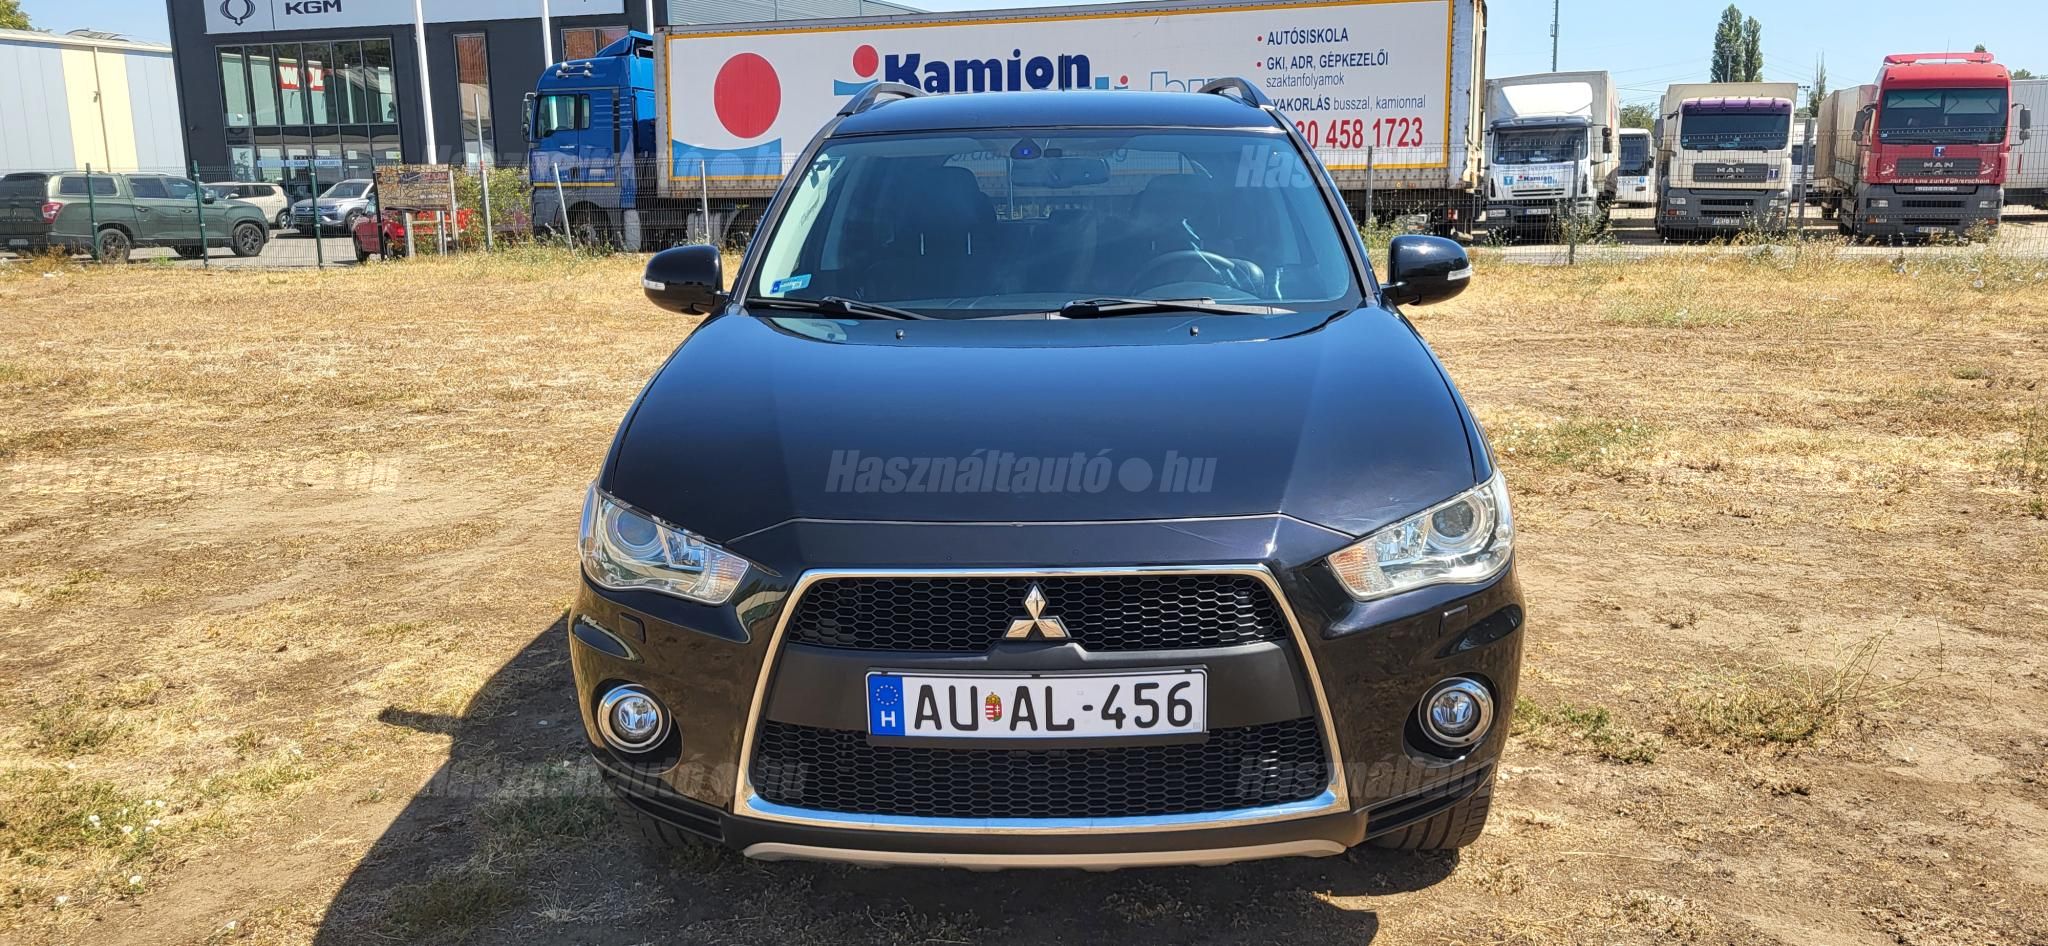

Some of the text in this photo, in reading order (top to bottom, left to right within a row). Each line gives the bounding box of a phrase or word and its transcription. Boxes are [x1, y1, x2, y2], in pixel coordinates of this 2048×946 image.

[285, 0, 342, 15] KGM
[1267, 27, 1349, 45] AUTÓSISKOLA
[1266, 48, 1389, 72] GKI, ADR, GÉPKEZELŐI
[884, 49, 1091, 93] Kamion
[1266, 72, 1345, 90] szaktanfolyamok
[1272, 93, 1426, 112] YAKORLÁS busszal, kamionnal
[1325, 118, 1364, 149] 458
[1372, 117, 1423, 148] 1723
[880, 710, 896, 728] H
